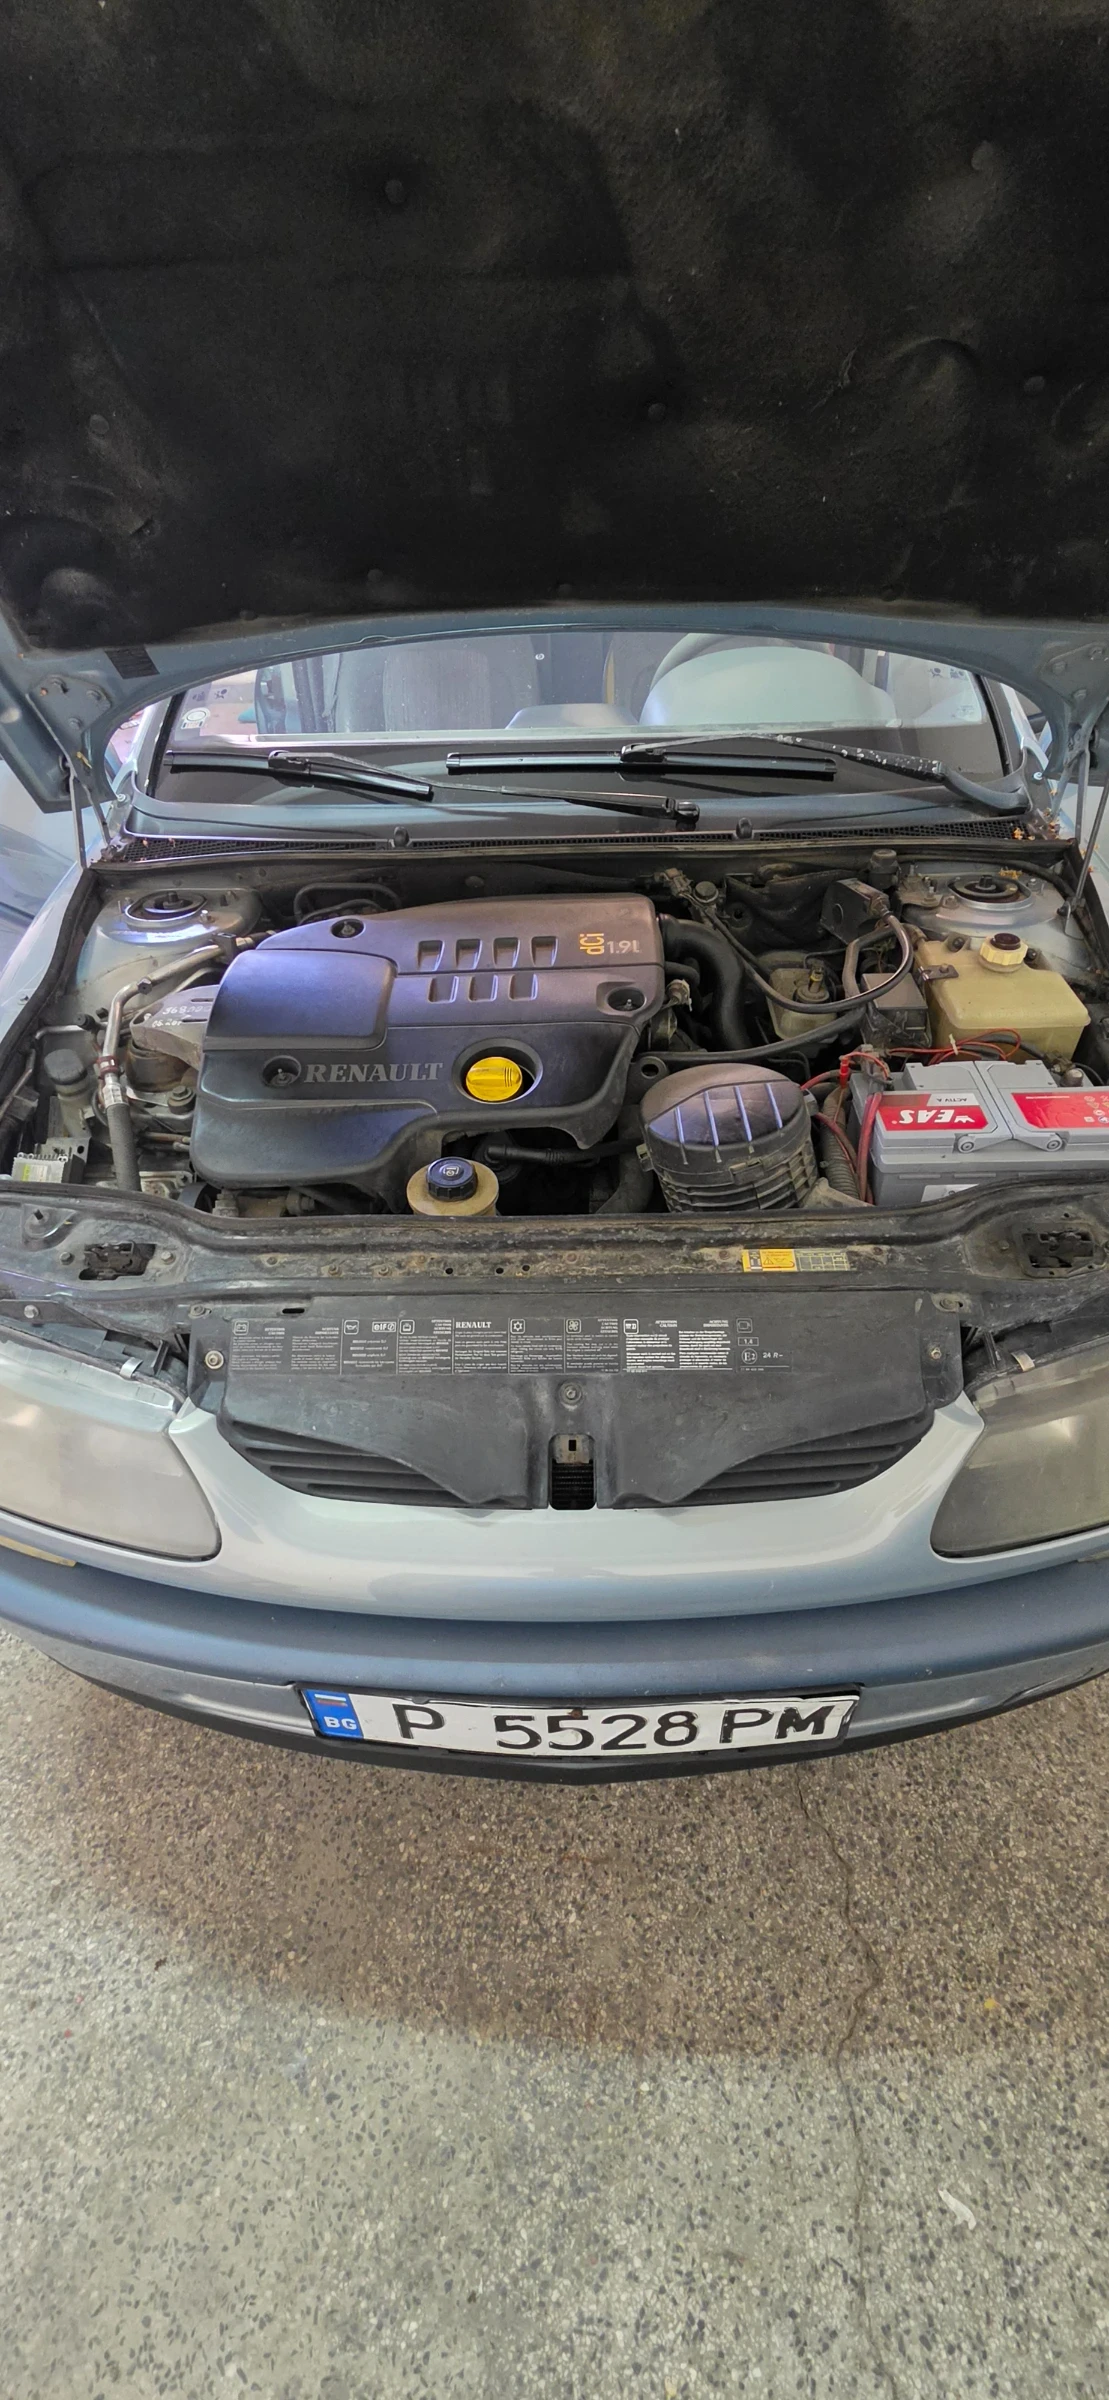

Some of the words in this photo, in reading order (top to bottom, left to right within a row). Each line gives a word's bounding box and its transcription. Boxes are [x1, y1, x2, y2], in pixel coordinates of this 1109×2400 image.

[579, 933, 605, 955] dCi
[303, 1062, 444, 1083] RENAULT
[374, 1322, 387, 1331] elf
[455, 1321, 492, 1329] RENAULT
[323, 1716, 358, 1731] BG
[392, 1703, 446, 1740] P
[493, 1710, 698, 1751] 5528
[719, 1704, 836, 1744] PM
